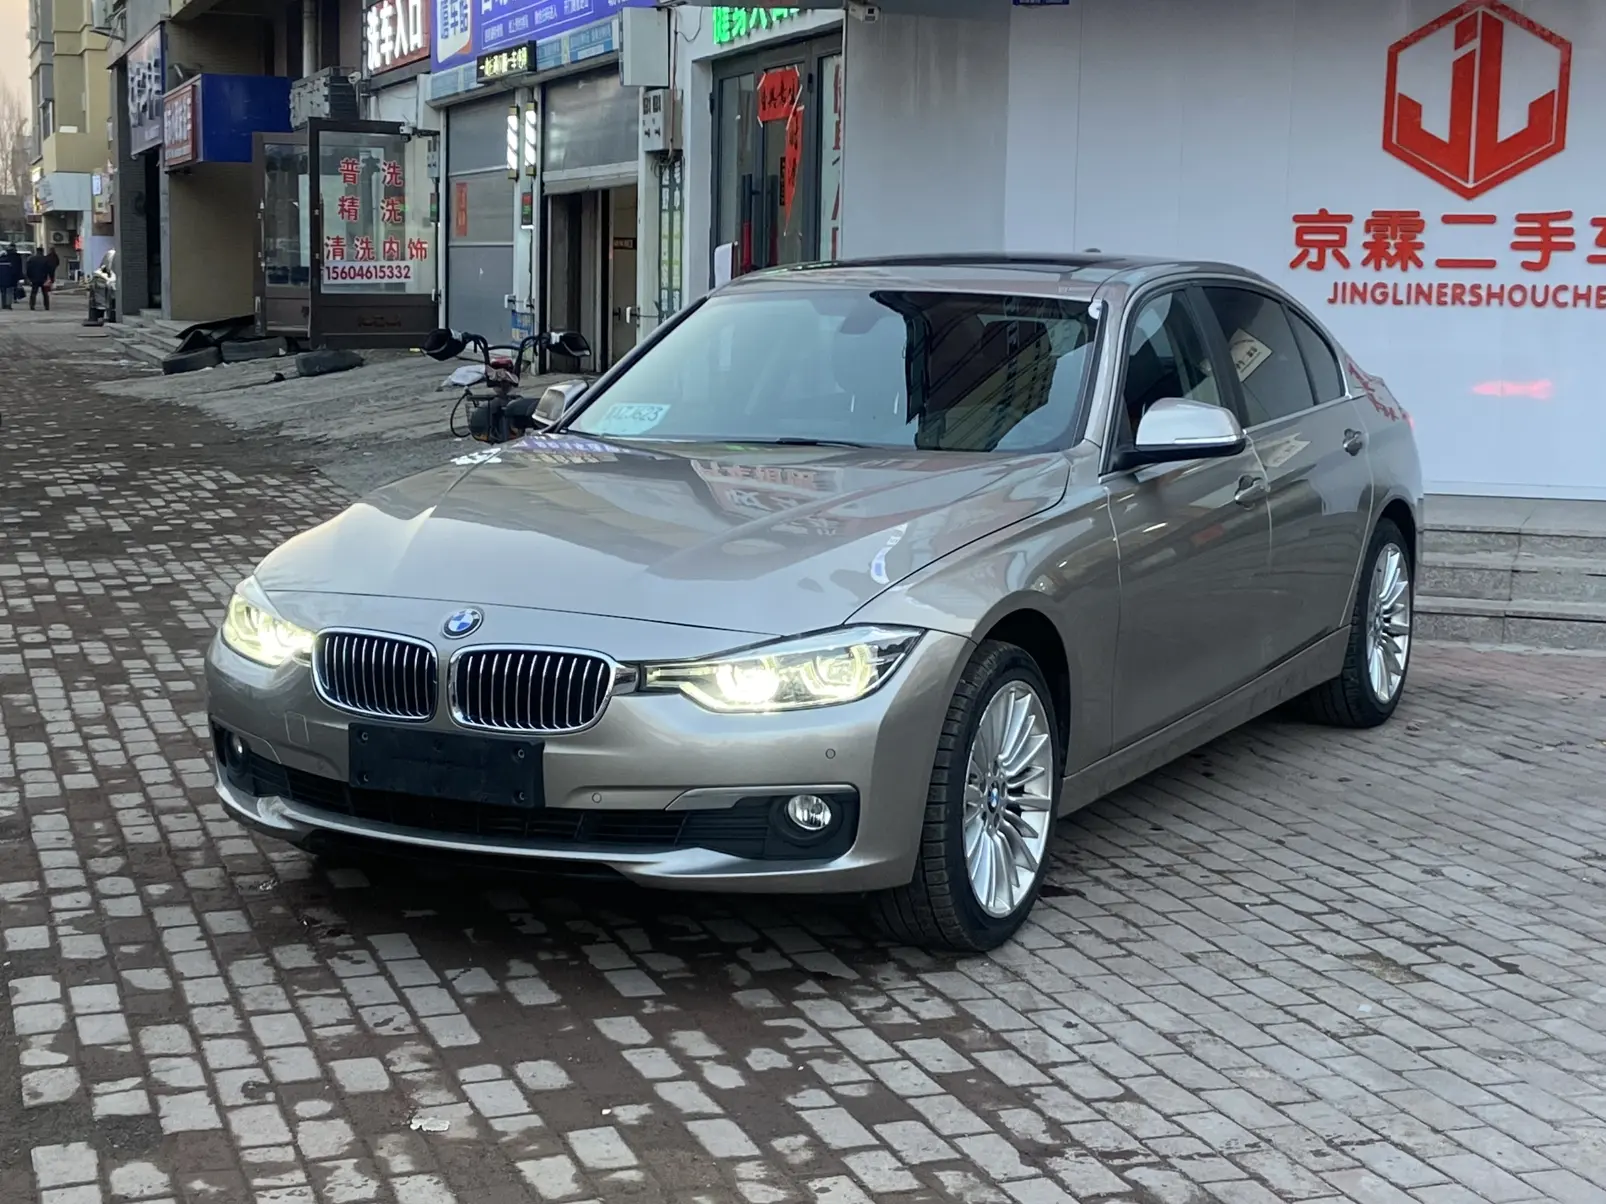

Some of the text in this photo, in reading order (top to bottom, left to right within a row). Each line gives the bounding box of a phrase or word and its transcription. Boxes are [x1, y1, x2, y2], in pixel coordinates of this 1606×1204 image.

[324, 235, 428, 261] 清洗内饰
[325, 264, 411, 280] 15604615332
[1327, 281, 1606, 309] JINGLINERSHOUCHE
